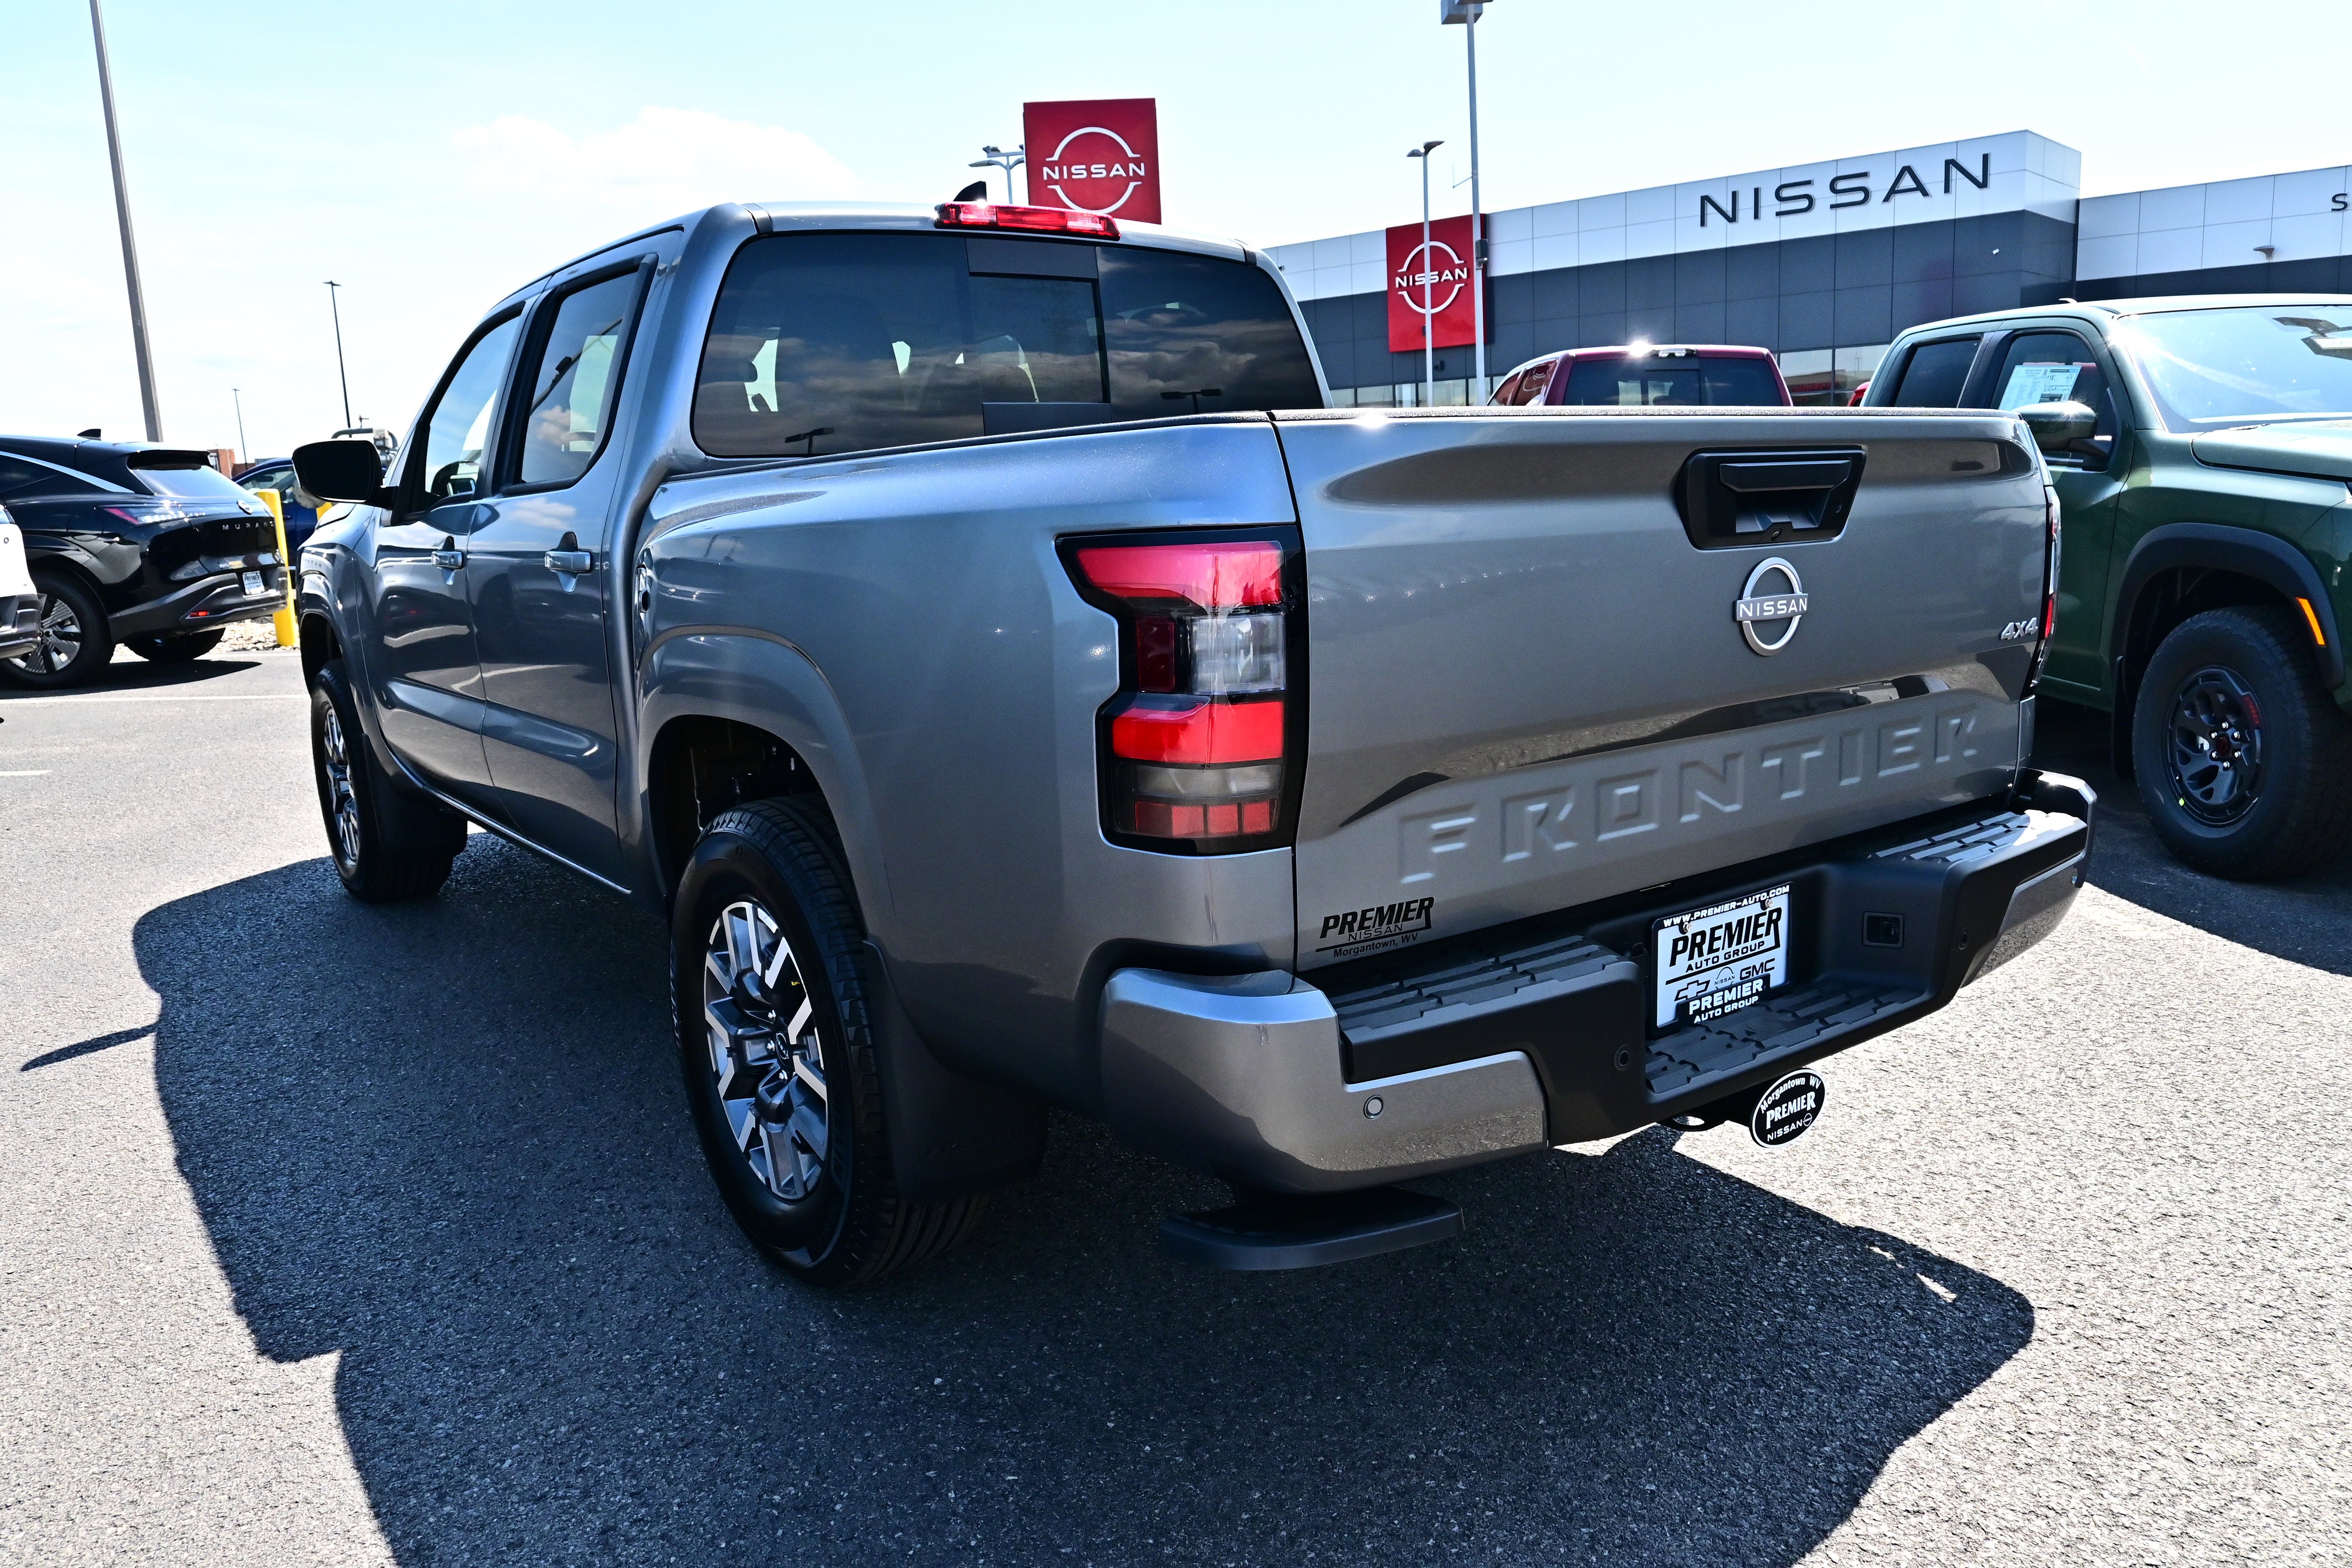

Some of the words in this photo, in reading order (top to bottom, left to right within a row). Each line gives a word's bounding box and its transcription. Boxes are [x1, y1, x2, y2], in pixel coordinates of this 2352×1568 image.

[1043, 163, 1145, 180] NISSAN
[1700, 152, 1990, 227] NISSAN
[1395, 267, 1467, 288] NISSAN
[1740, 598, 1807, 617] NISSAN
[1399, 702, 1978, 884] FRONTIER
[1319, 896, 1435, 939] PREMIER
[1663, 885, 1789, 928] WWW.PREMIER-AUTO.COM
[1333, 939, 1398, 958] Morgantown,
[1401, 932, 1418, 942] WV
[1348, 923, 1403, 942] NISSAN
[1669, 907, 1782, 967] PREMIER
[1685, 956, 1719, 972] AUTO
[1724, 941, 1765, 961] GROUP
[1714, 975, 1735, 986] NISSAN
[1740, 958, 1775, 980] GMC
[1689, 978, 1764, 1015] PREMIER
[1694, 1008, 1721, 1024] AUTO
[1724, 996, 1759, 1013] GROUP
[1760, 1078, 1805, 1114] Morgantown
[1810, 1075, 1821, 1089] WV
[1766, 1092, 1816, 1130] PREMIER
[1767, 1119, 1803, 1142] NISSAN
